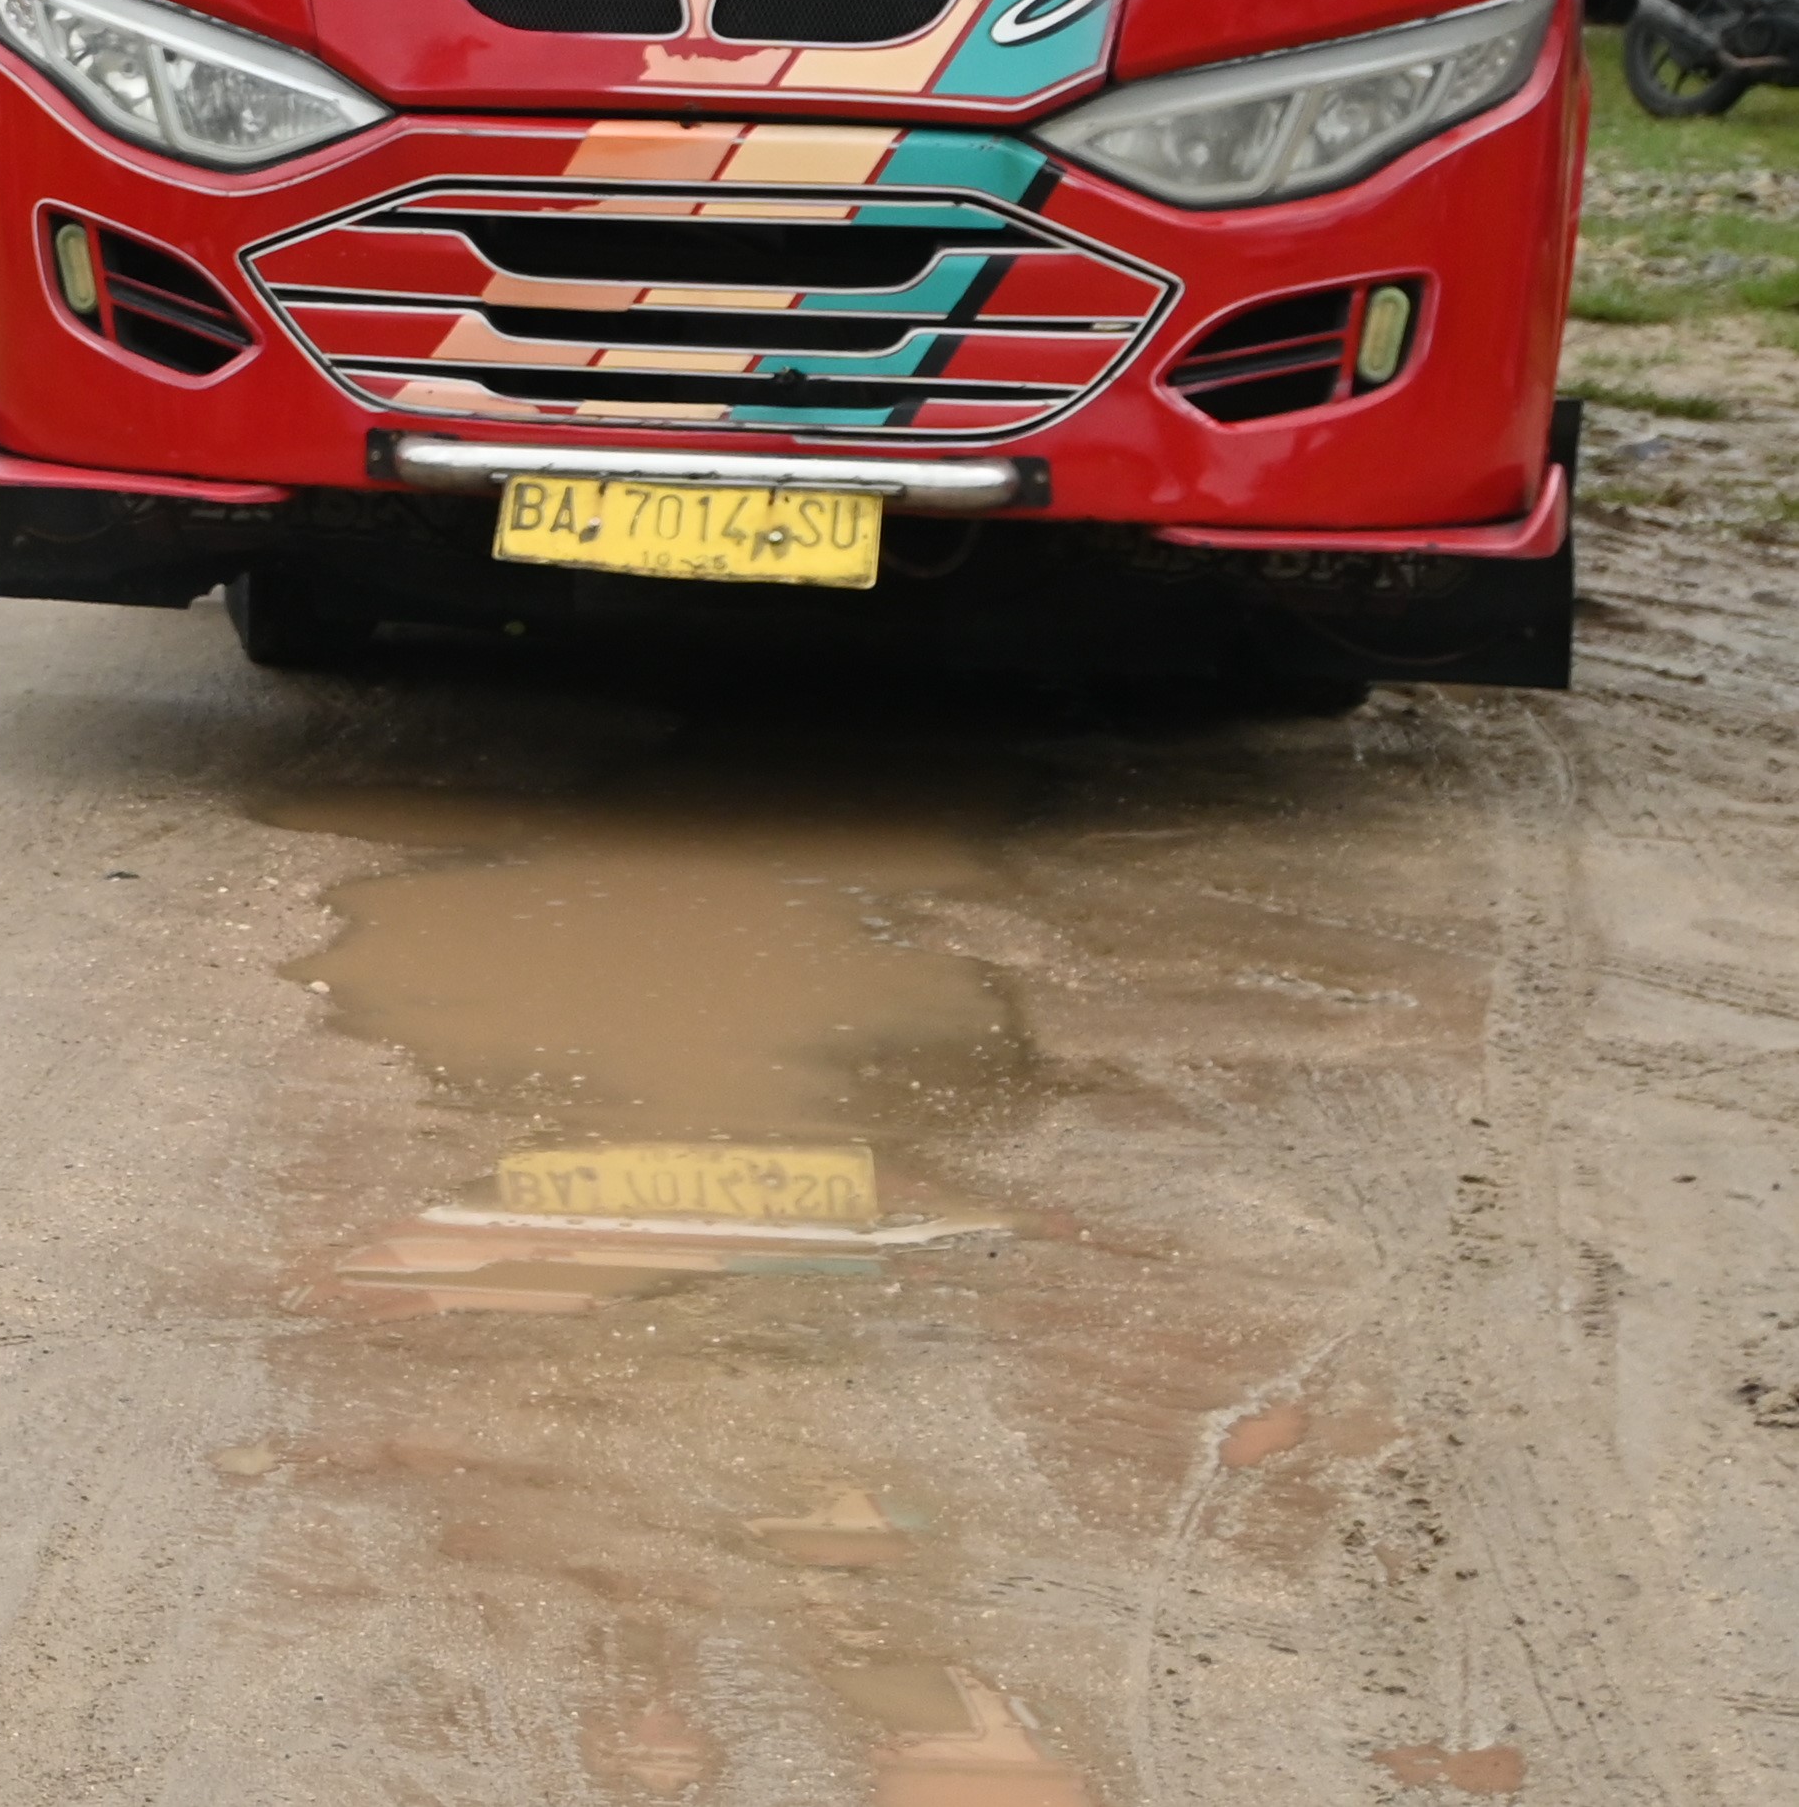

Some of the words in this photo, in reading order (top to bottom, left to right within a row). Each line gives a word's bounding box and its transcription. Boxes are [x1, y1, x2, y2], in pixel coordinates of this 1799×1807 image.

[510, 482, 578, 534] BA
[625, 488, 748, 547] 7014
[799, 497, 863, 549] SU
